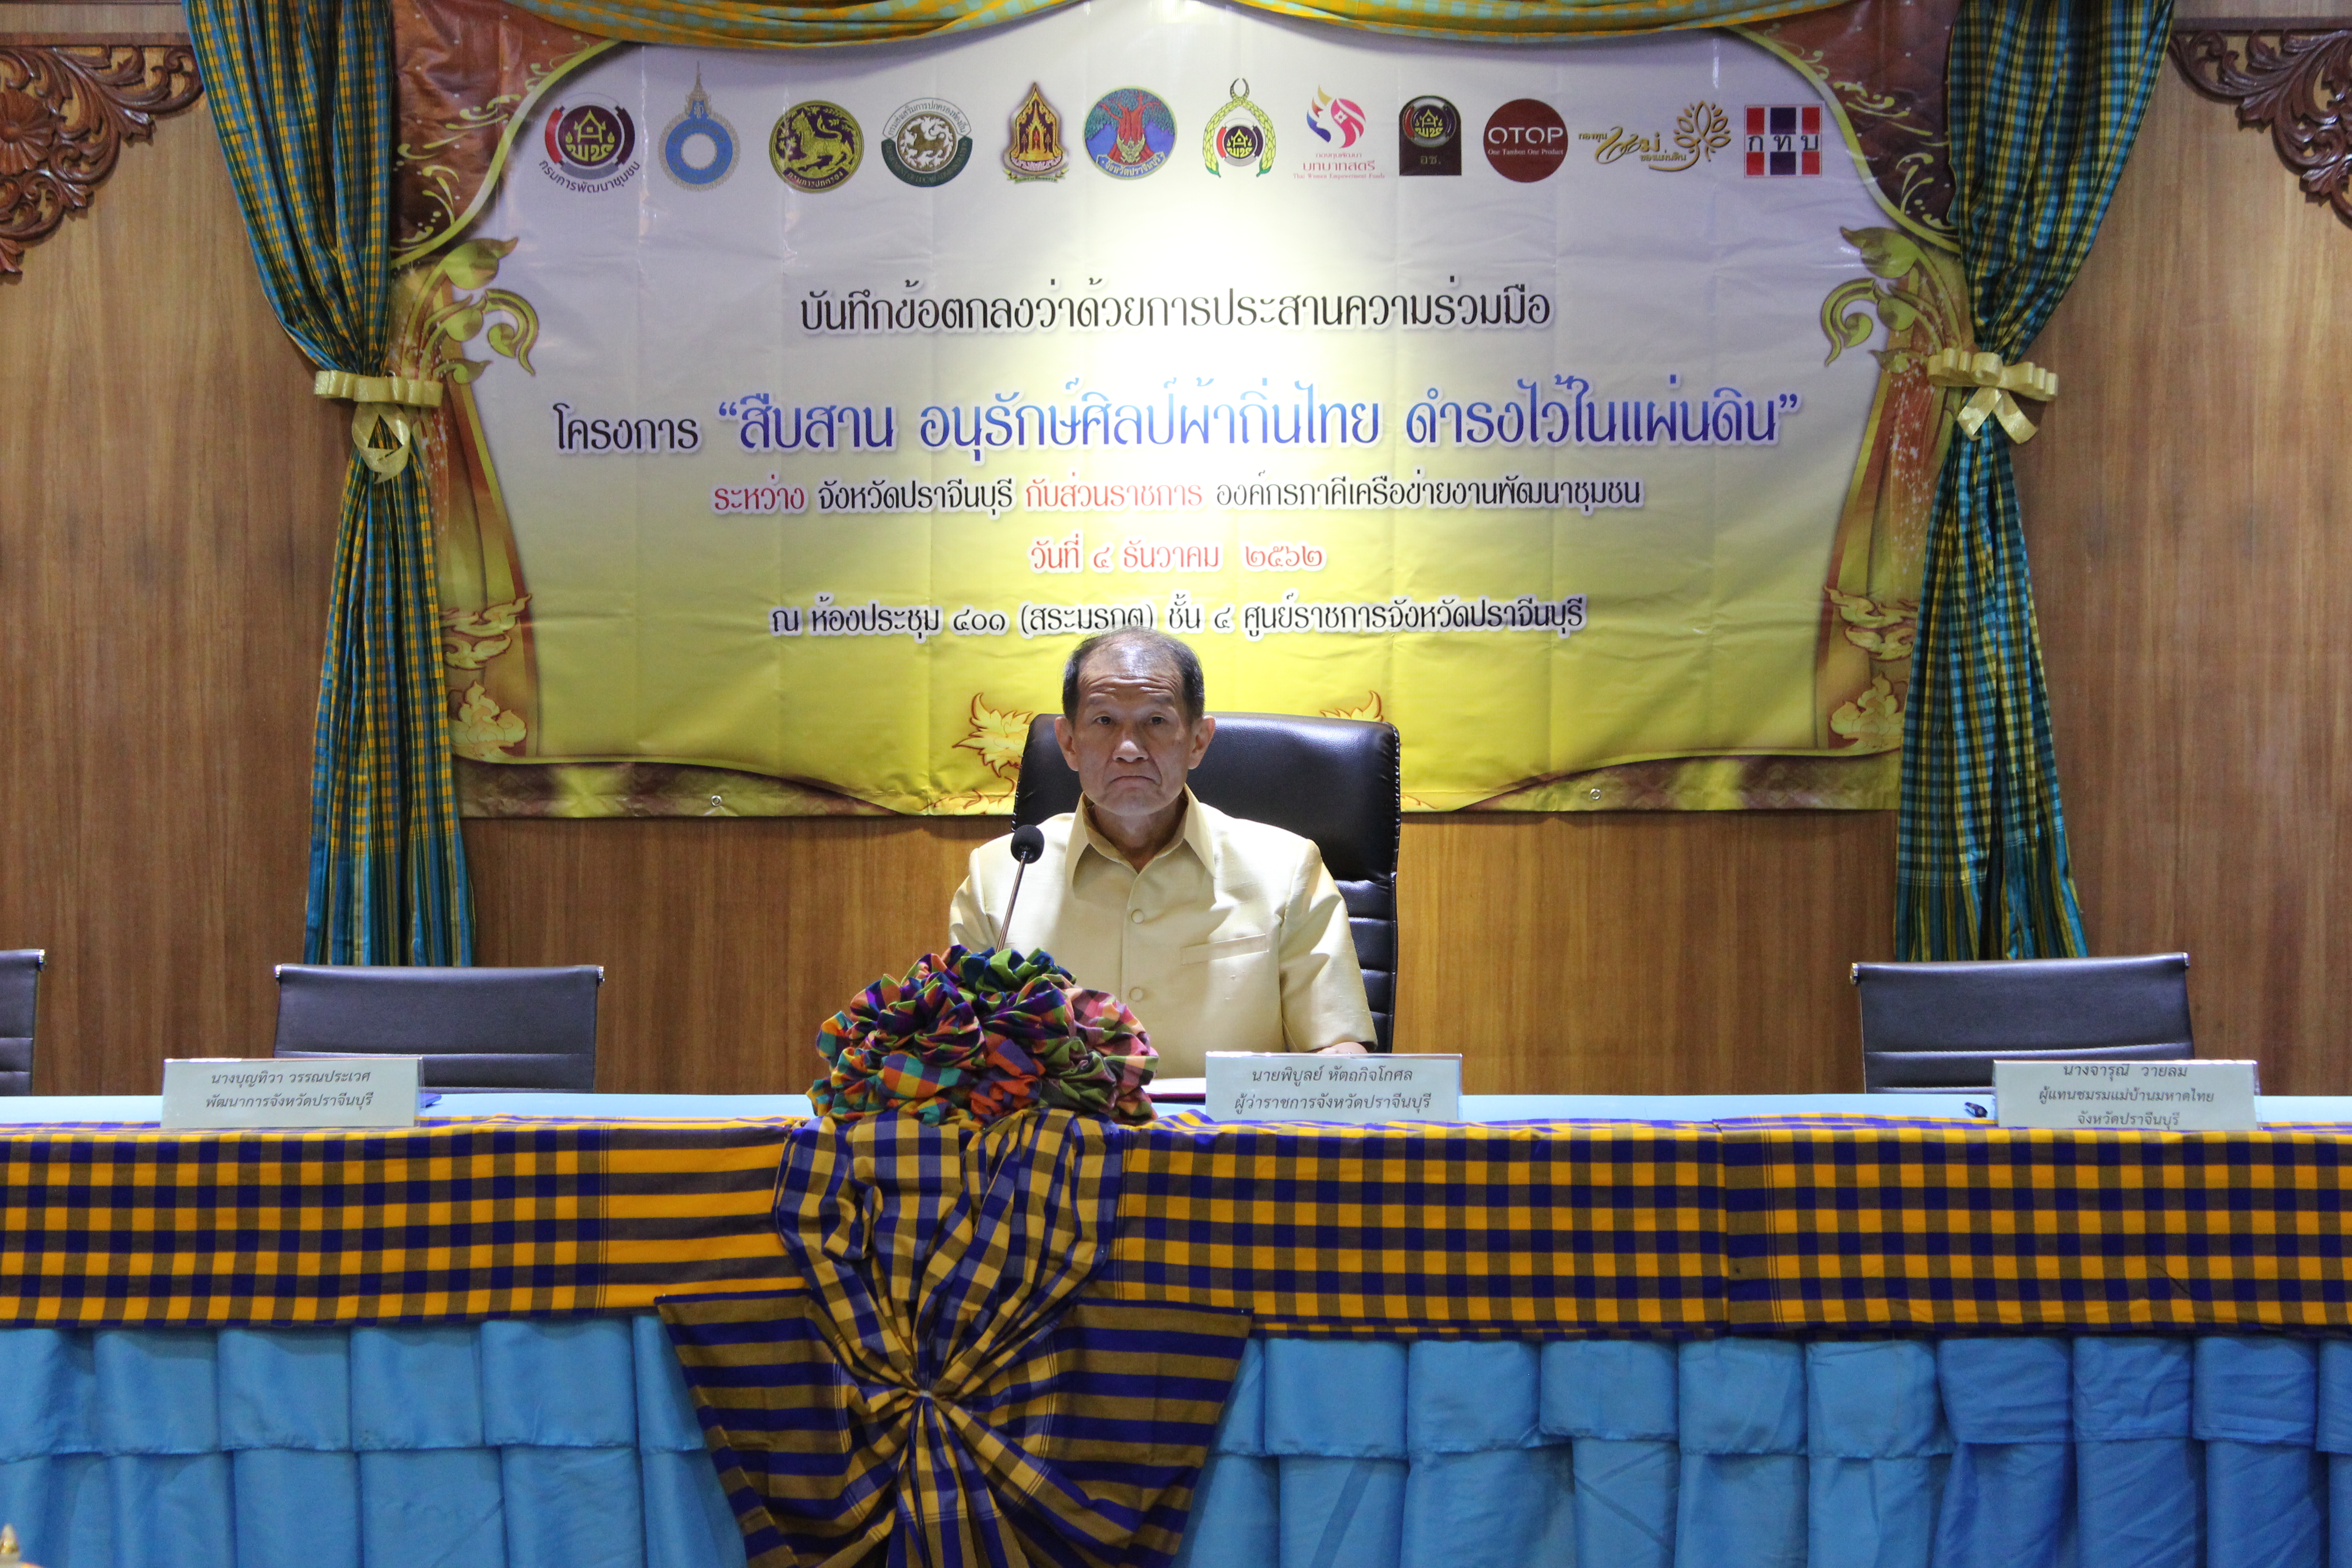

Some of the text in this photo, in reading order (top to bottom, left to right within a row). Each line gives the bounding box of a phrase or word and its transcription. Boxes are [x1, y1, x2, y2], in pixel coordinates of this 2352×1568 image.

[1488, 126, 1564, 145] OTOP
[539, 161, 641, 193] กรมการพัฒนาชุมชน
[1303, 160, 1375, 171] บทบาทสตรี
[801, 275, 1550, 330] บันทึกข้อตกลงว่าด้วยการประสานความร่วมมือ
[553, 402, 699, 450] โครงการ
[920, 377, 1378, 461] อนุรักษ์ศิลป์ผ้าถิ่นไทย
[715, 469, 1640, 516] ระหว่าง จังหวัดปราจีนบุรี กับส่วนราชการ องค์กรภาคีเครือข่ายงานพัฒนาชุมชน
[1031, 534, 1323, 569] วันที่ ๔ ธันวาคม ๒๕๖๒
[773, 592, 1583, 639] ณ ห้องประชุม ๔๐๑ (สระมรกต) ชั้น ๔ ศูนย์ราชการจังหวัดปราจีนบุรี
[211, 1070, 371, 1088] นางบุญทิวา วรรณประเวศ
[1252, 1064, 1413, 1087] นายพิบูลย์ หัตถกิจโกศล
[2141, 1066, 2188, 1077] วายลม
[206, 1091, 374, 1111] พัฒนาการจังหวัดปราจีนบุรี
[1235, 1092, 1432, 1115] ผู้ว่าราชการจังหวัดปราจีนบุรี
[2039, 1086, 2215, 1105] ผู้แทนชมรมแม่บ้านมหาดไทย
[2078, 1110, 2180, 1131] จังหวัดปราจีนบุรี
